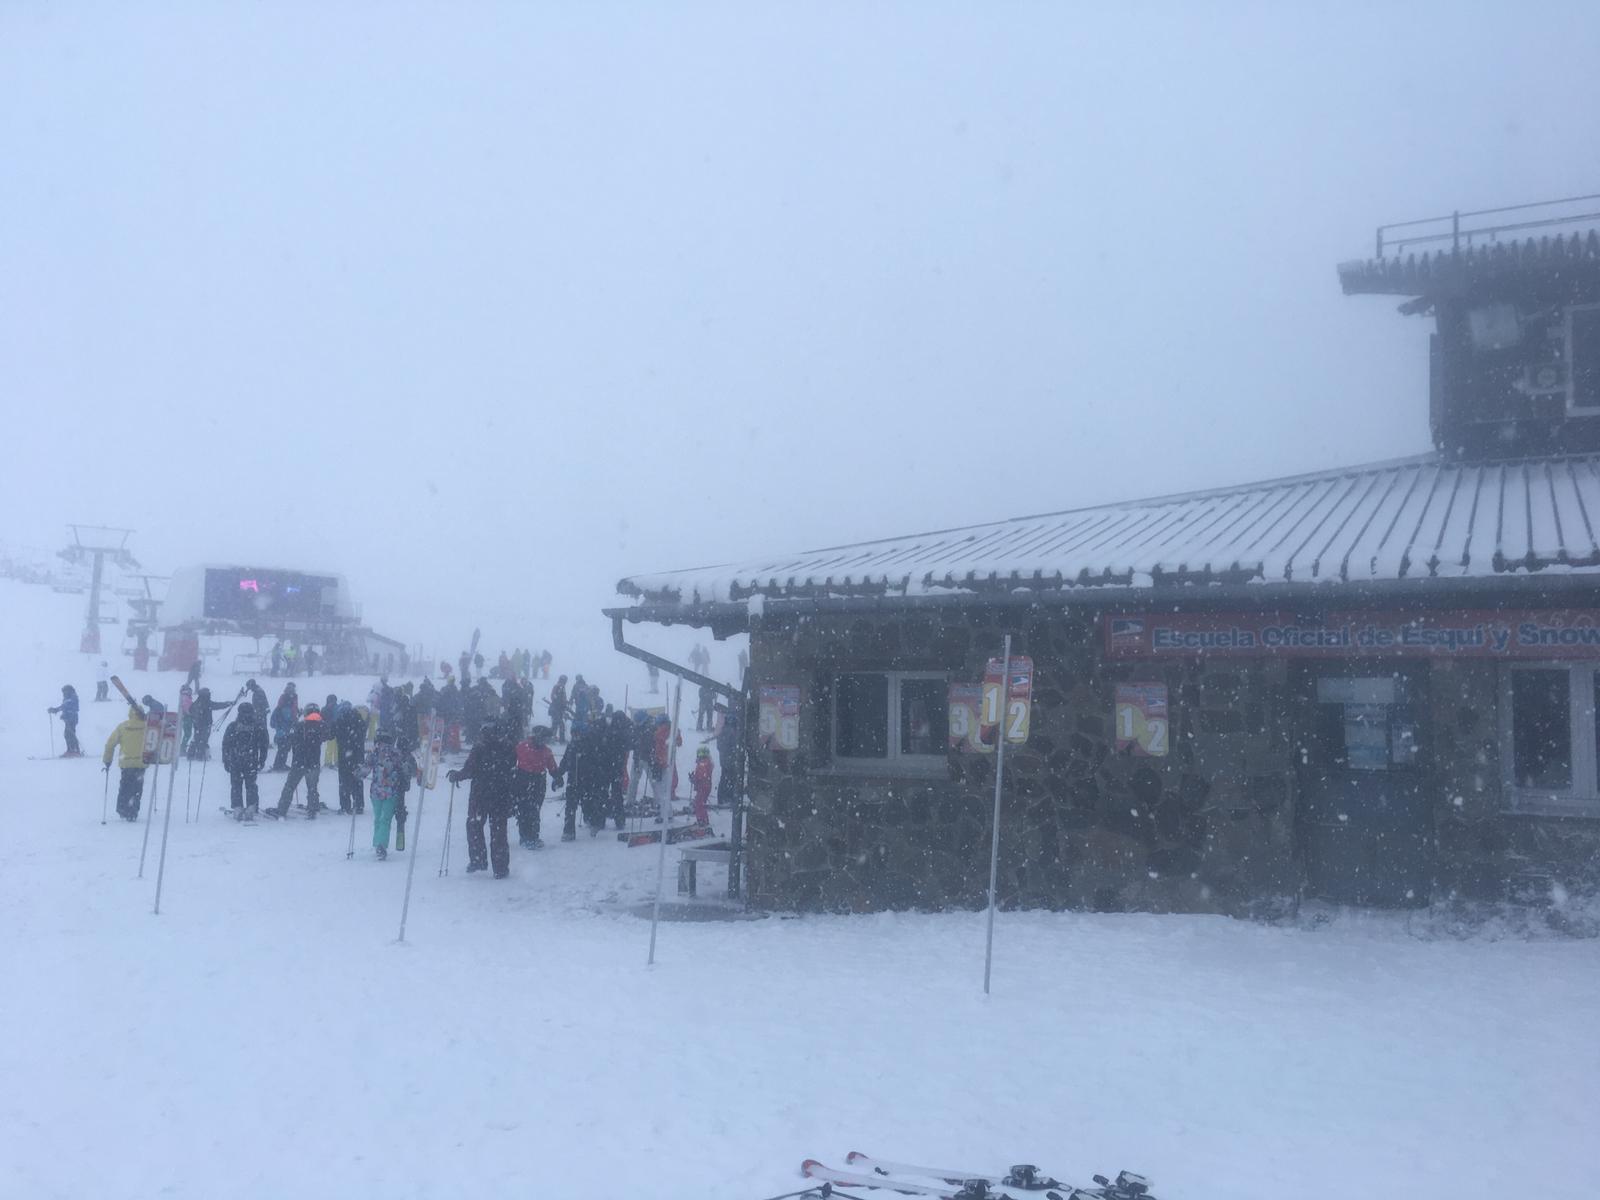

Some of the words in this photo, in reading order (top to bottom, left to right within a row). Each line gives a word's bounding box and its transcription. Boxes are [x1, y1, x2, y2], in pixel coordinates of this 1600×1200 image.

[1152, 626, 1256, 648] Escuela
[1261, 624, 1349, 648] Oficial
[1358, 624, 1393, 646] de
[1489, 626, 1510, 652] y
[985, 687, 998, 722] 1
[1007, 702, 1027, 738] 2
[781, 718, 796, 748] 6
[951, 704, 969, 737] 3
[1119, 707, 1133, 737] 1
[1147, 720, 1166, 752] 2
[145, 729, 159, 752] 9
